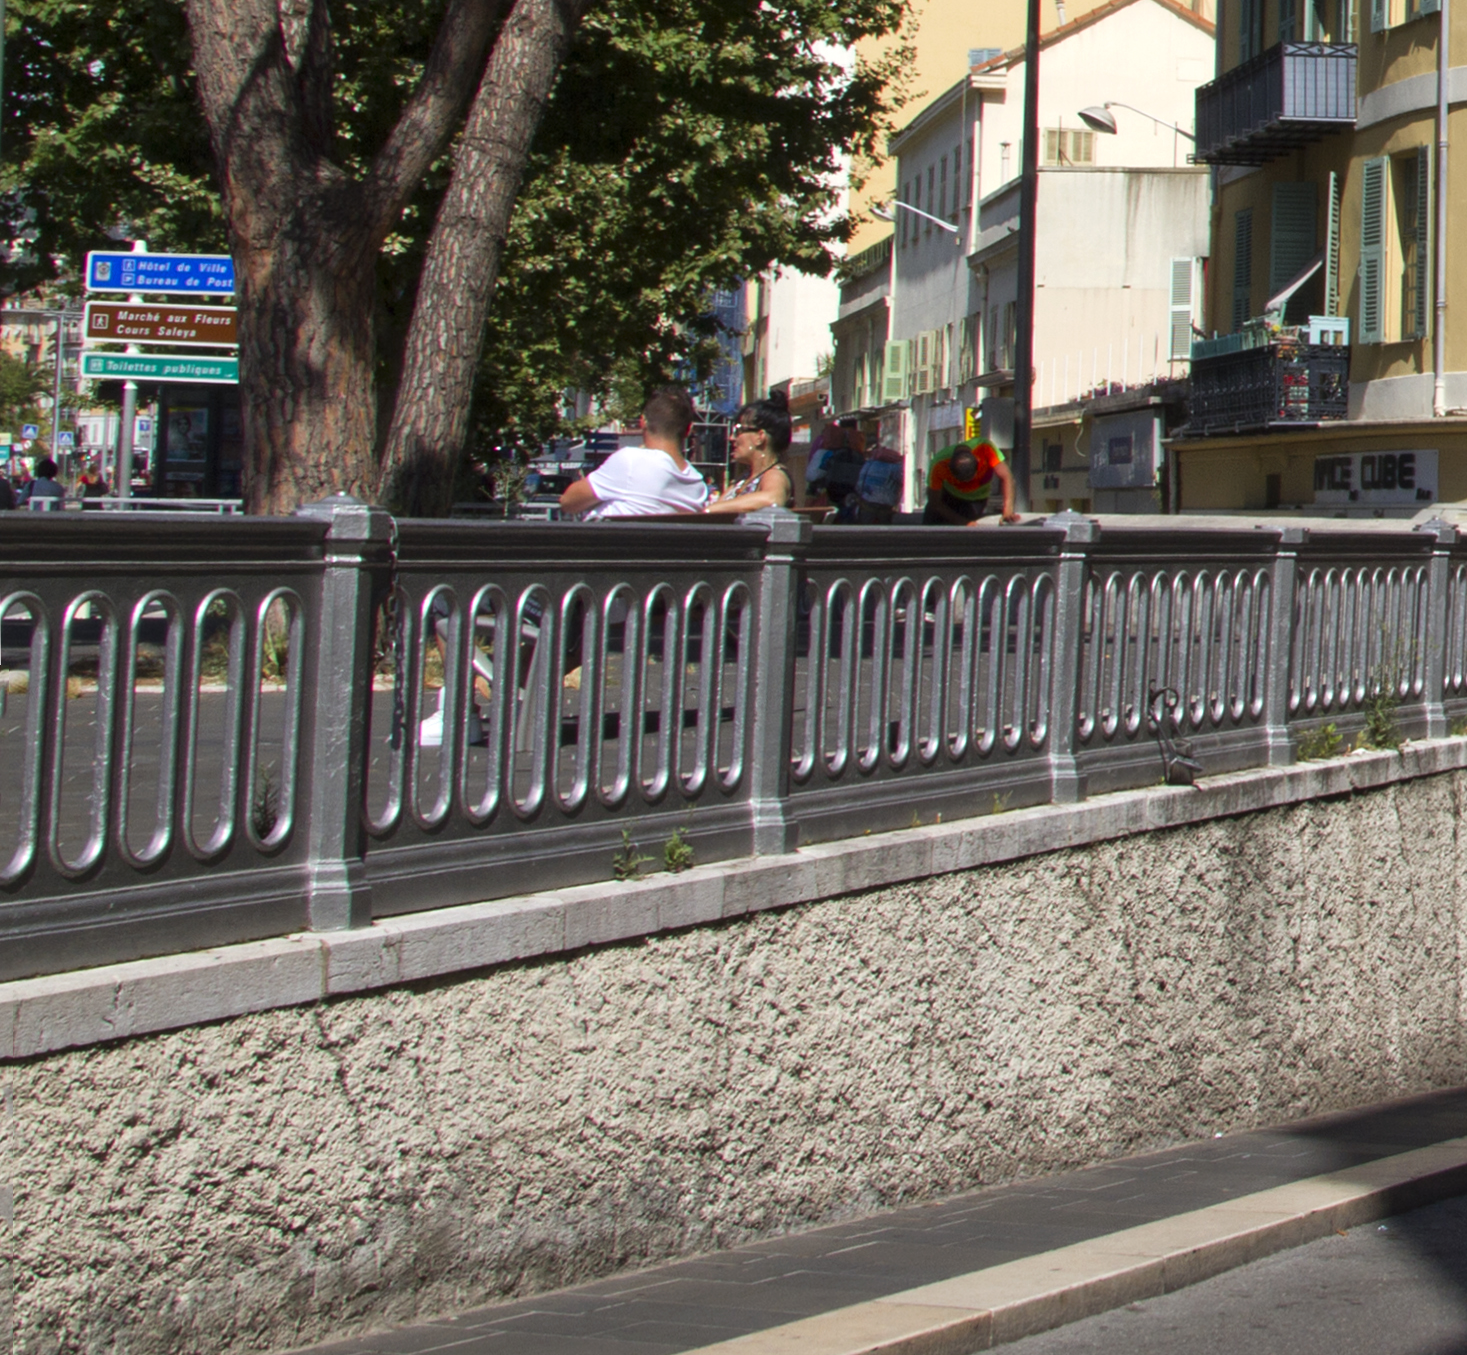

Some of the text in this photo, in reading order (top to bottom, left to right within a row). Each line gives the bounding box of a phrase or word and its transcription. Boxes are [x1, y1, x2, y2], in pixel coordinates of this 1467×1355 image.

[138, 260, 227, 274] Hôtel de Ville
[136, 274, 233, 287] Bureau de Post
[117, 311, 231, 325] Marché aux Fleurs
[116, 324, 196, 338] Cours Saleya
[106, 360, 222, 376] Toilettes publiques
[1361, 452, 1417, 489] CUBE
